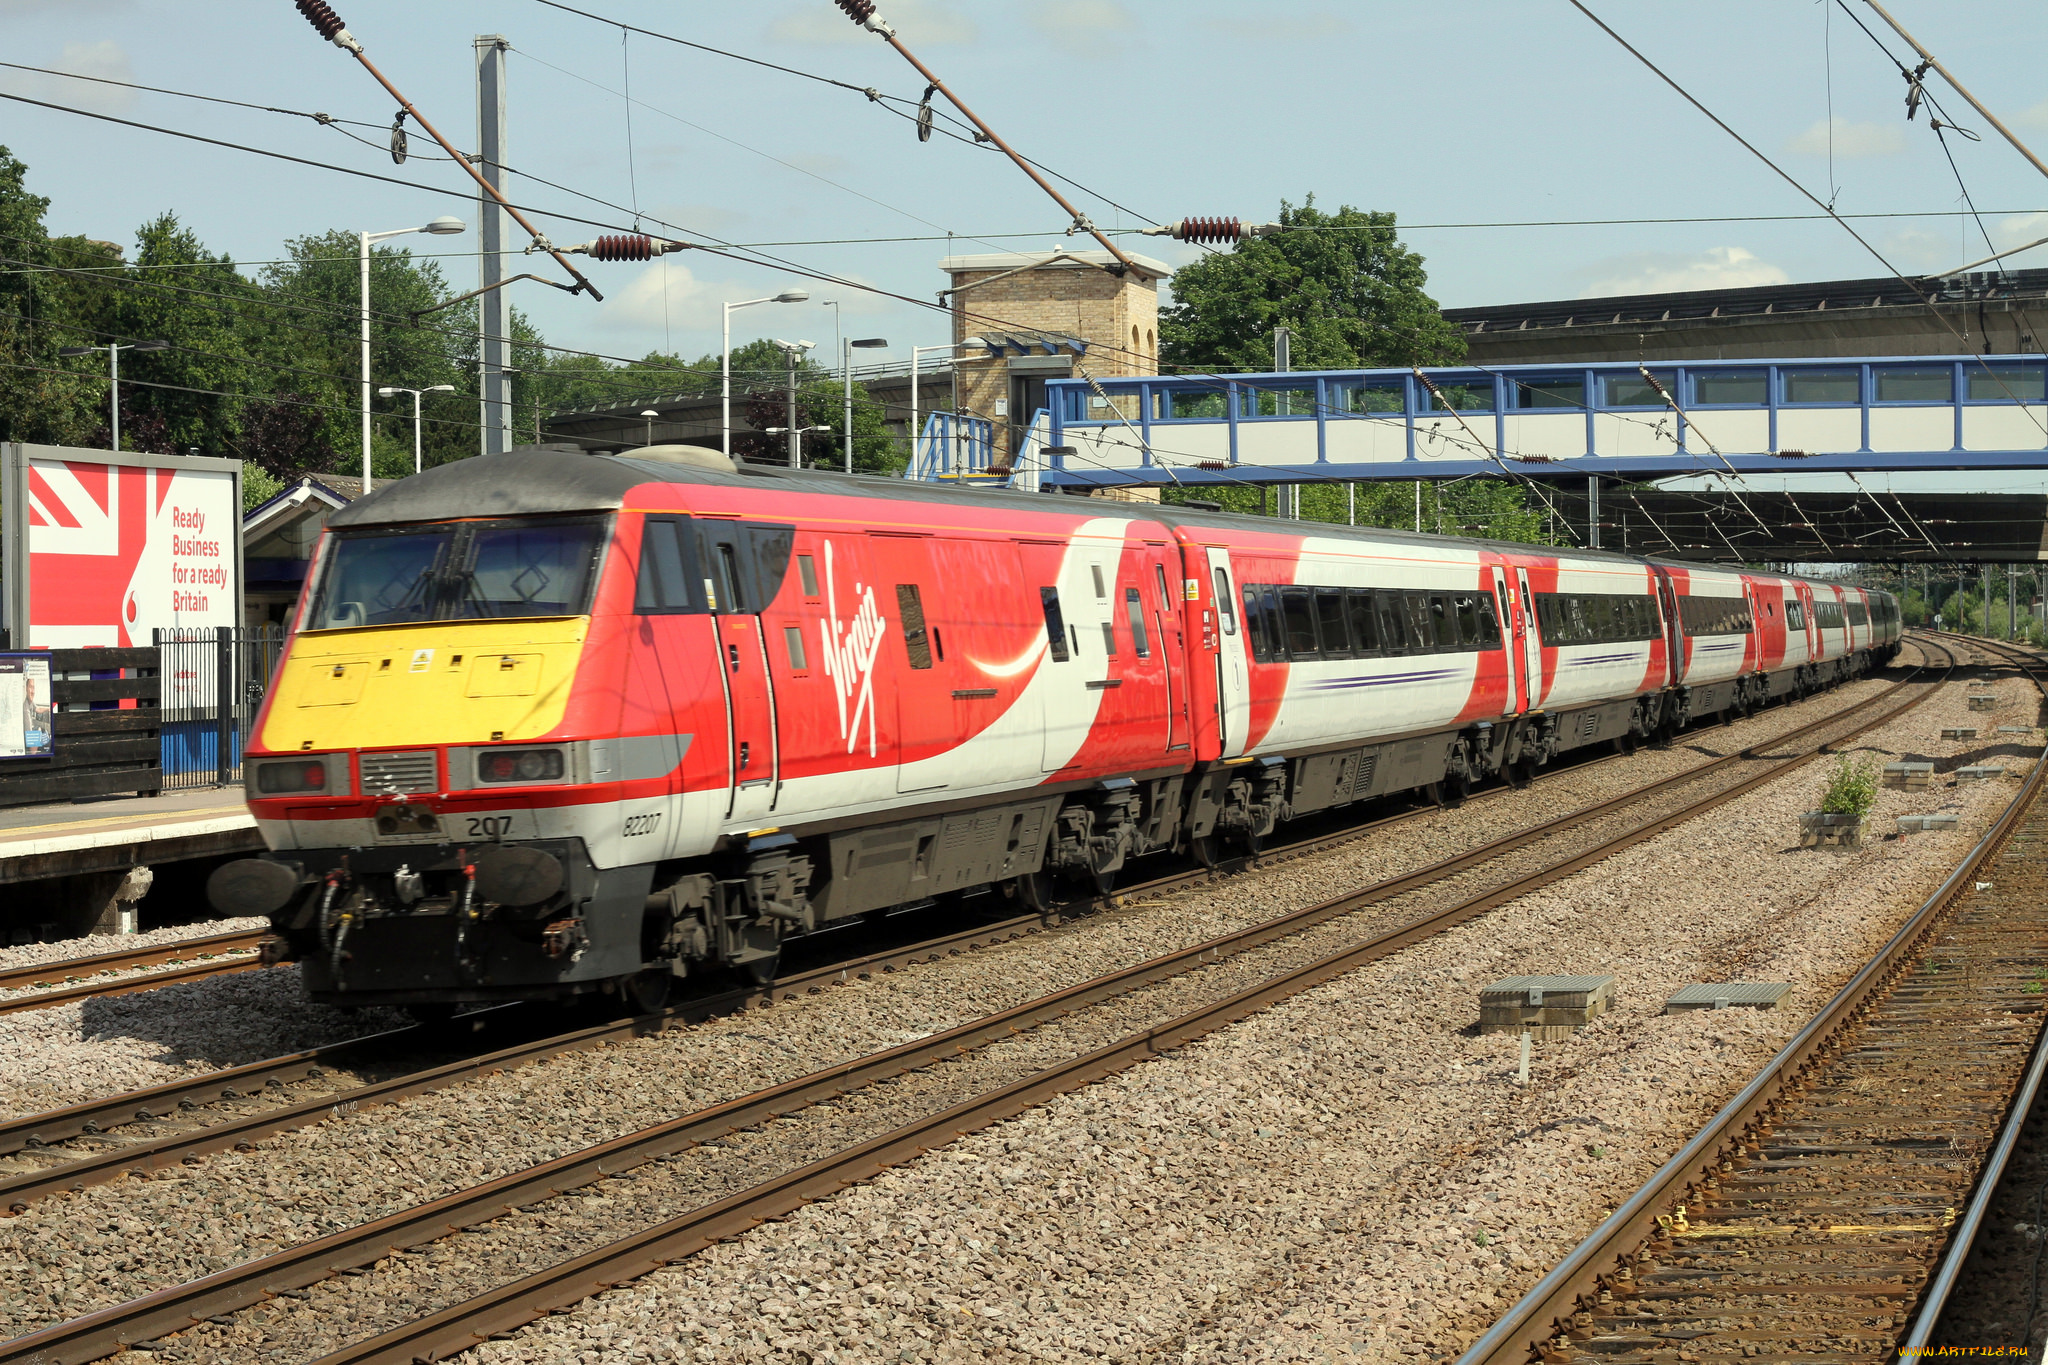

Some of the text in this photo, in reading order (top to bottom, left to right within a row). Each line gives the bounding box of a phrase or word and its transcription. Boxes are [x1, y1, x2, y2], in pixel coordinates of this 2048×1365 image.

[173, 506, 205, 534] Ready
[173, 534, 219, 557] Business
[172, 562, 227, 590] for a ready
[173, 590, 208, 611] Britain
[820, 539, 886, 758] Virgin
[466, 816, 512, 836] 207
[622, 813, 662, 837] 82207
